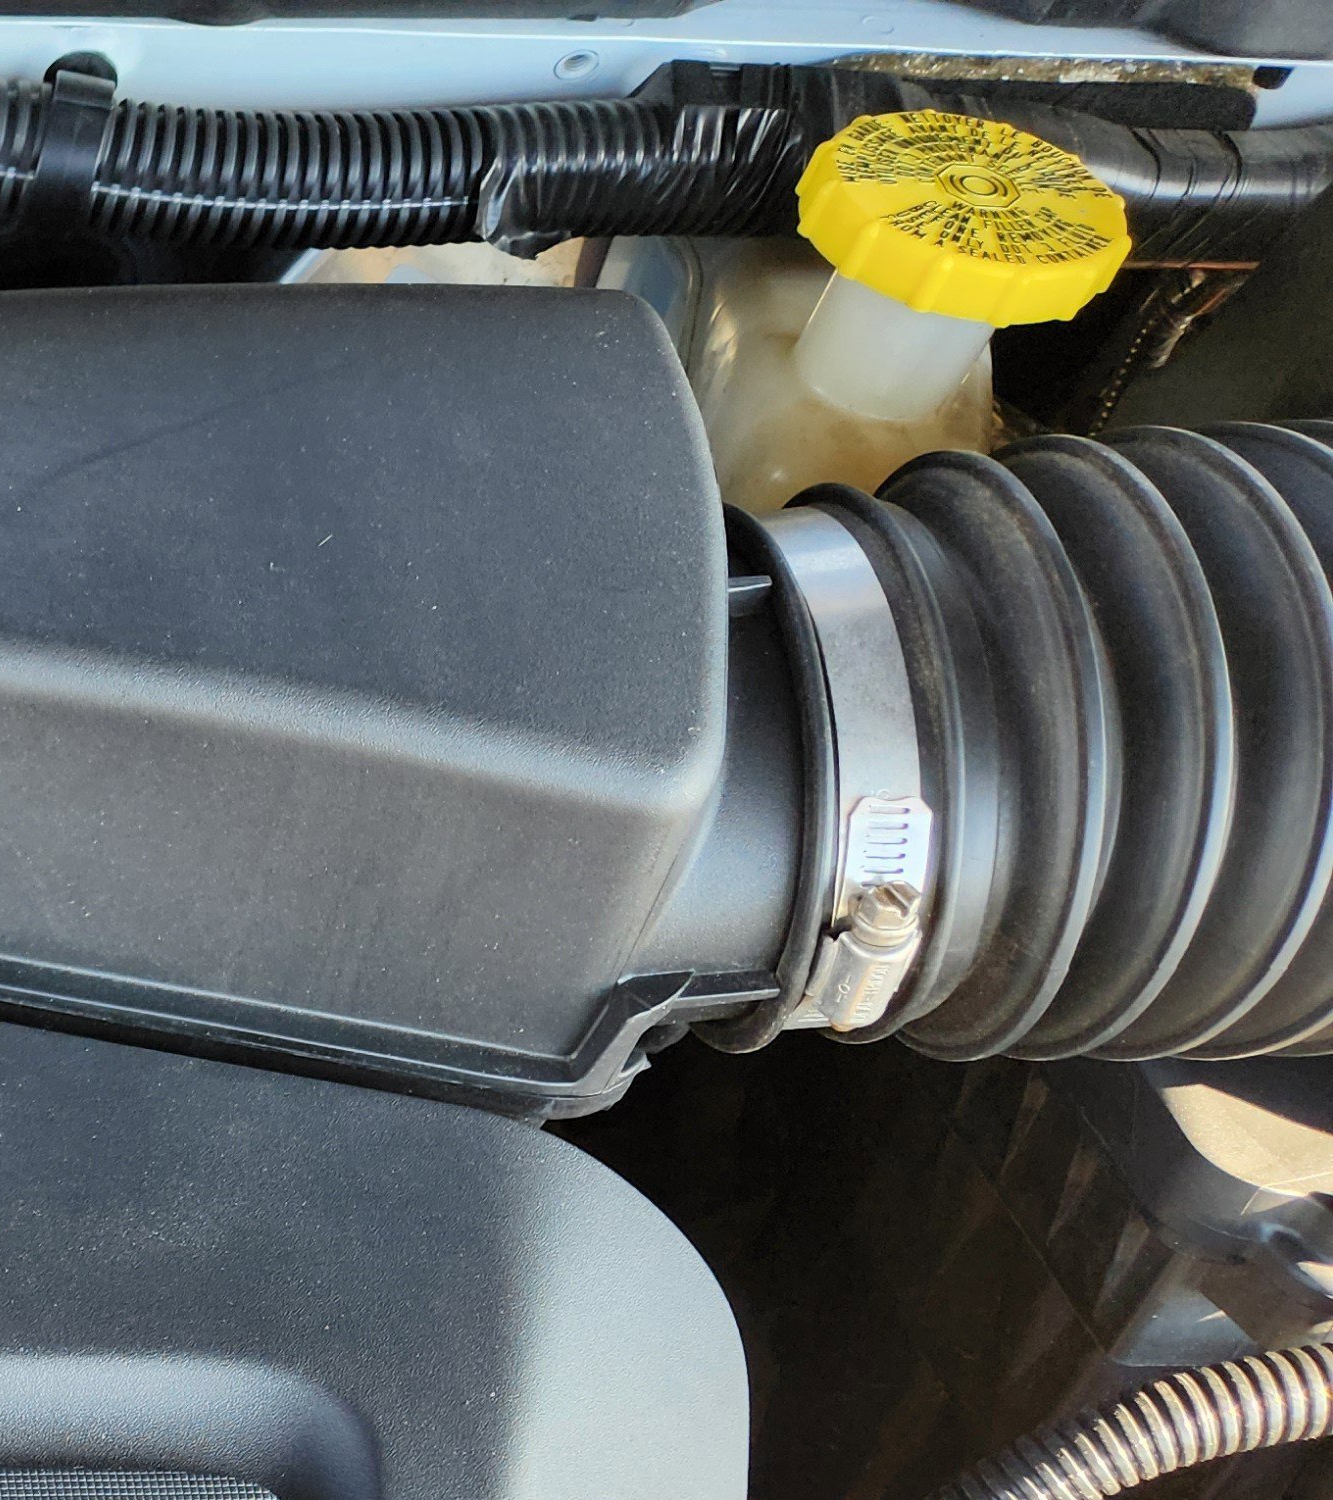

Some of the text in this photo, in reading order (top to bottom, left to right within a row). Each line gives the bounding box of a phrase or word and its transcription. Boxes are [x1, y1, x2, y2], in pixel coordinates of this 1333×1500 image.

[898, 113, 984, 128] NETTOYER
[908, 204, 1075, 243] BEFORE REMOVING
[922, 200, 971, 224] CLEAN
[983, 218, 1036, 231] FILLER
[952, 200, 1030, 221] WARNING
[879, 213, 927, 239] FROM
[933, 238, 945, 248] A
[957, 245, 1027, 264] SEALED
[939, 230, 984, 249] ONLY
[999, 243, 1033, 254] DOT
